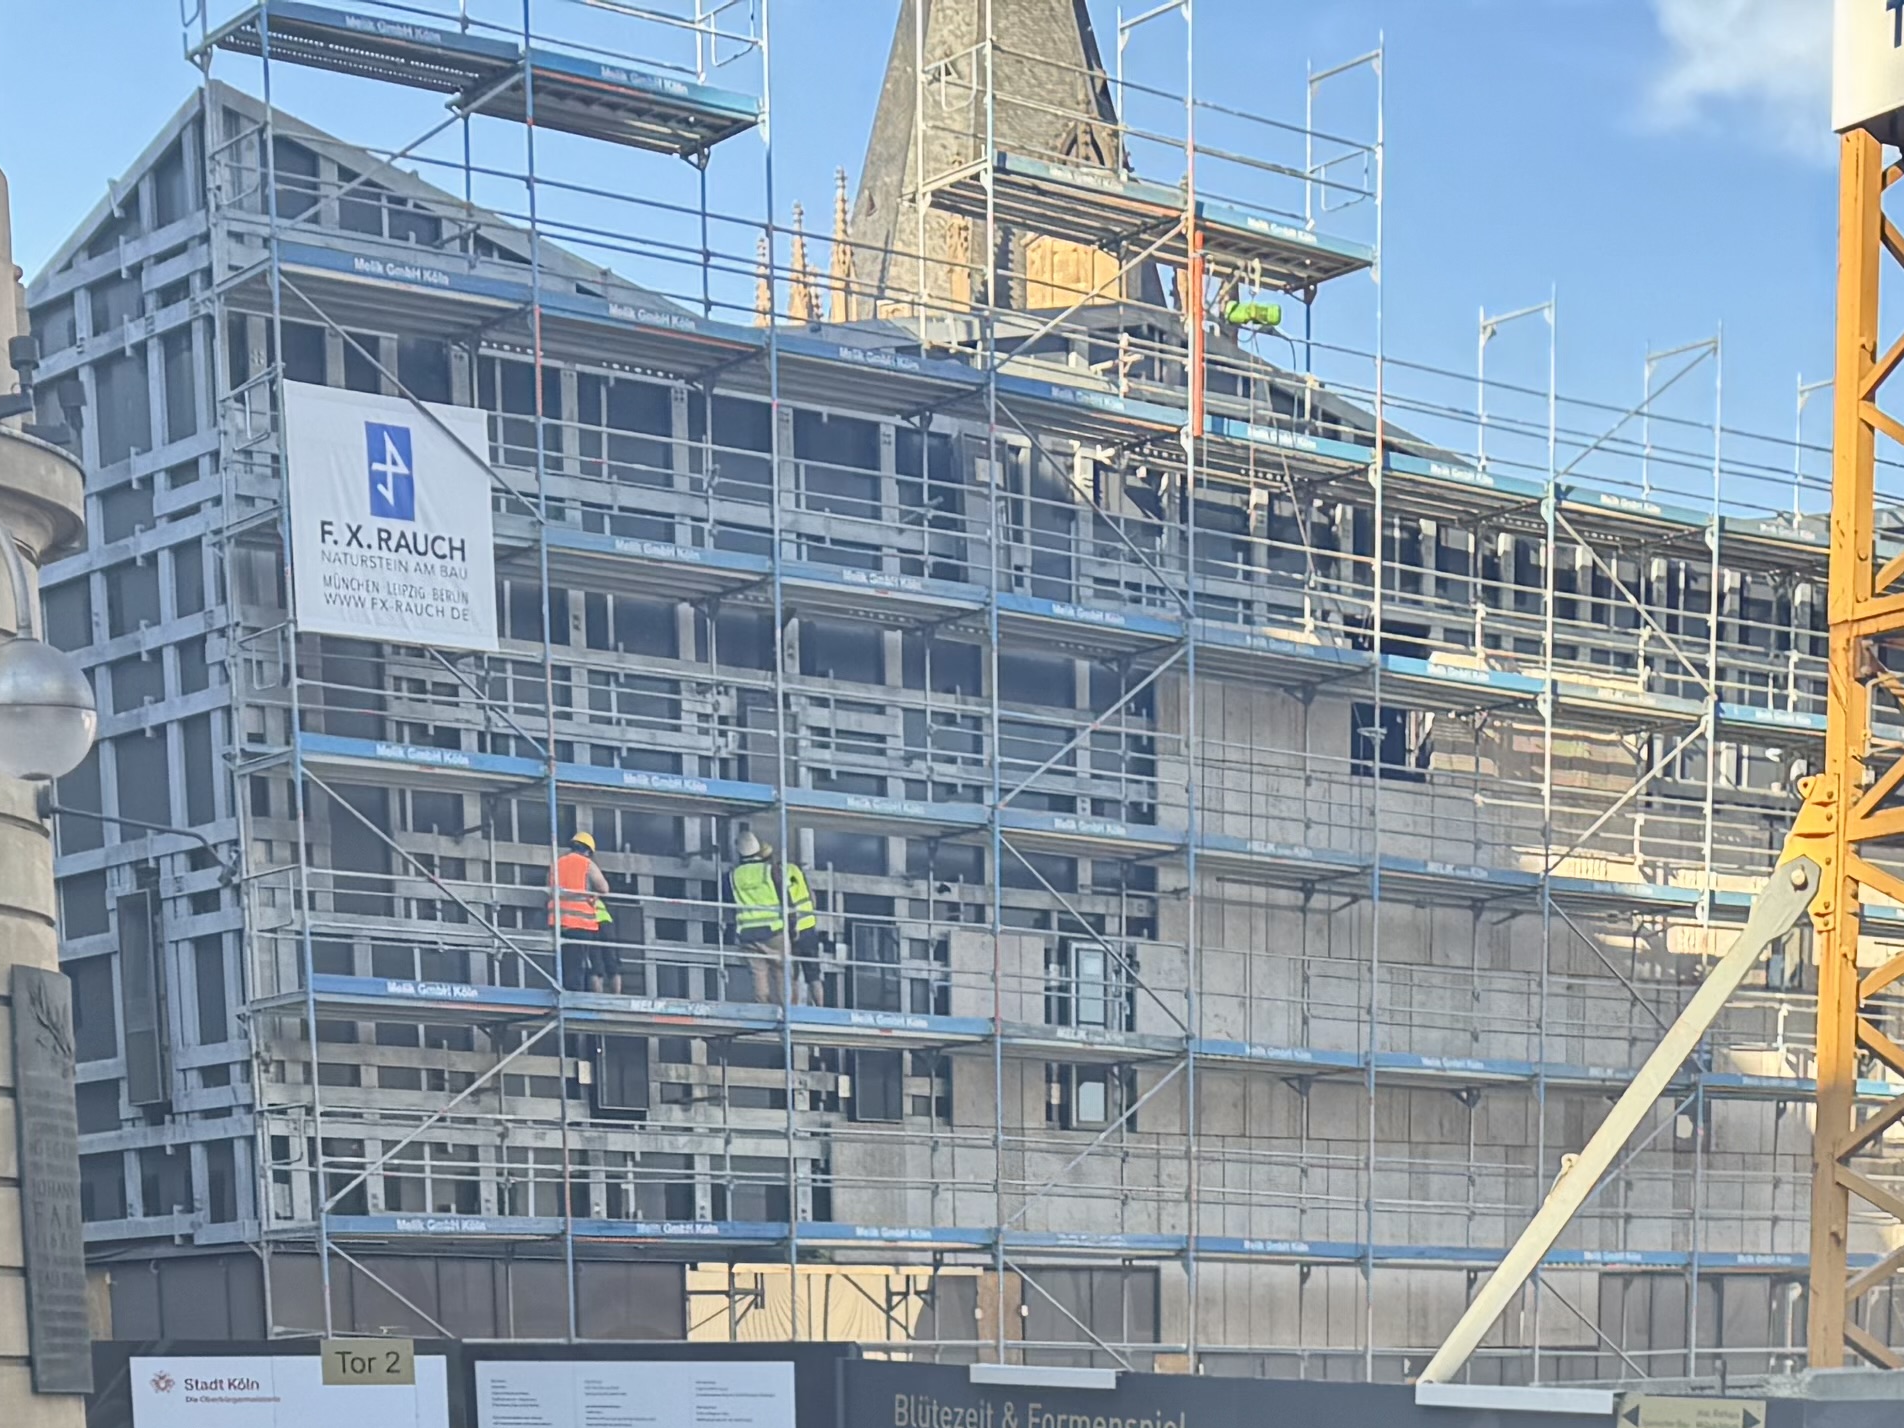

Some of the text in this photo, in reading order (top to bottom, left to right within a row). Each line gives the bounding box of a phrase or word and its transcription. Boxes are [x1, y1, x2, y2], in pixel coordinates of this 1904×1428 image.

[320, 520, 466, 563] F. X. RAUCH
[321, 551, 468, 580] NATURSTEIN AM BAU
[323, 575, 469, 605] MÜNCHEN LEIPZIG BERLIN
[335, 1351, 401, 1375] Tor 2
[185, 1376, 260, 1392] Stadt Köln
